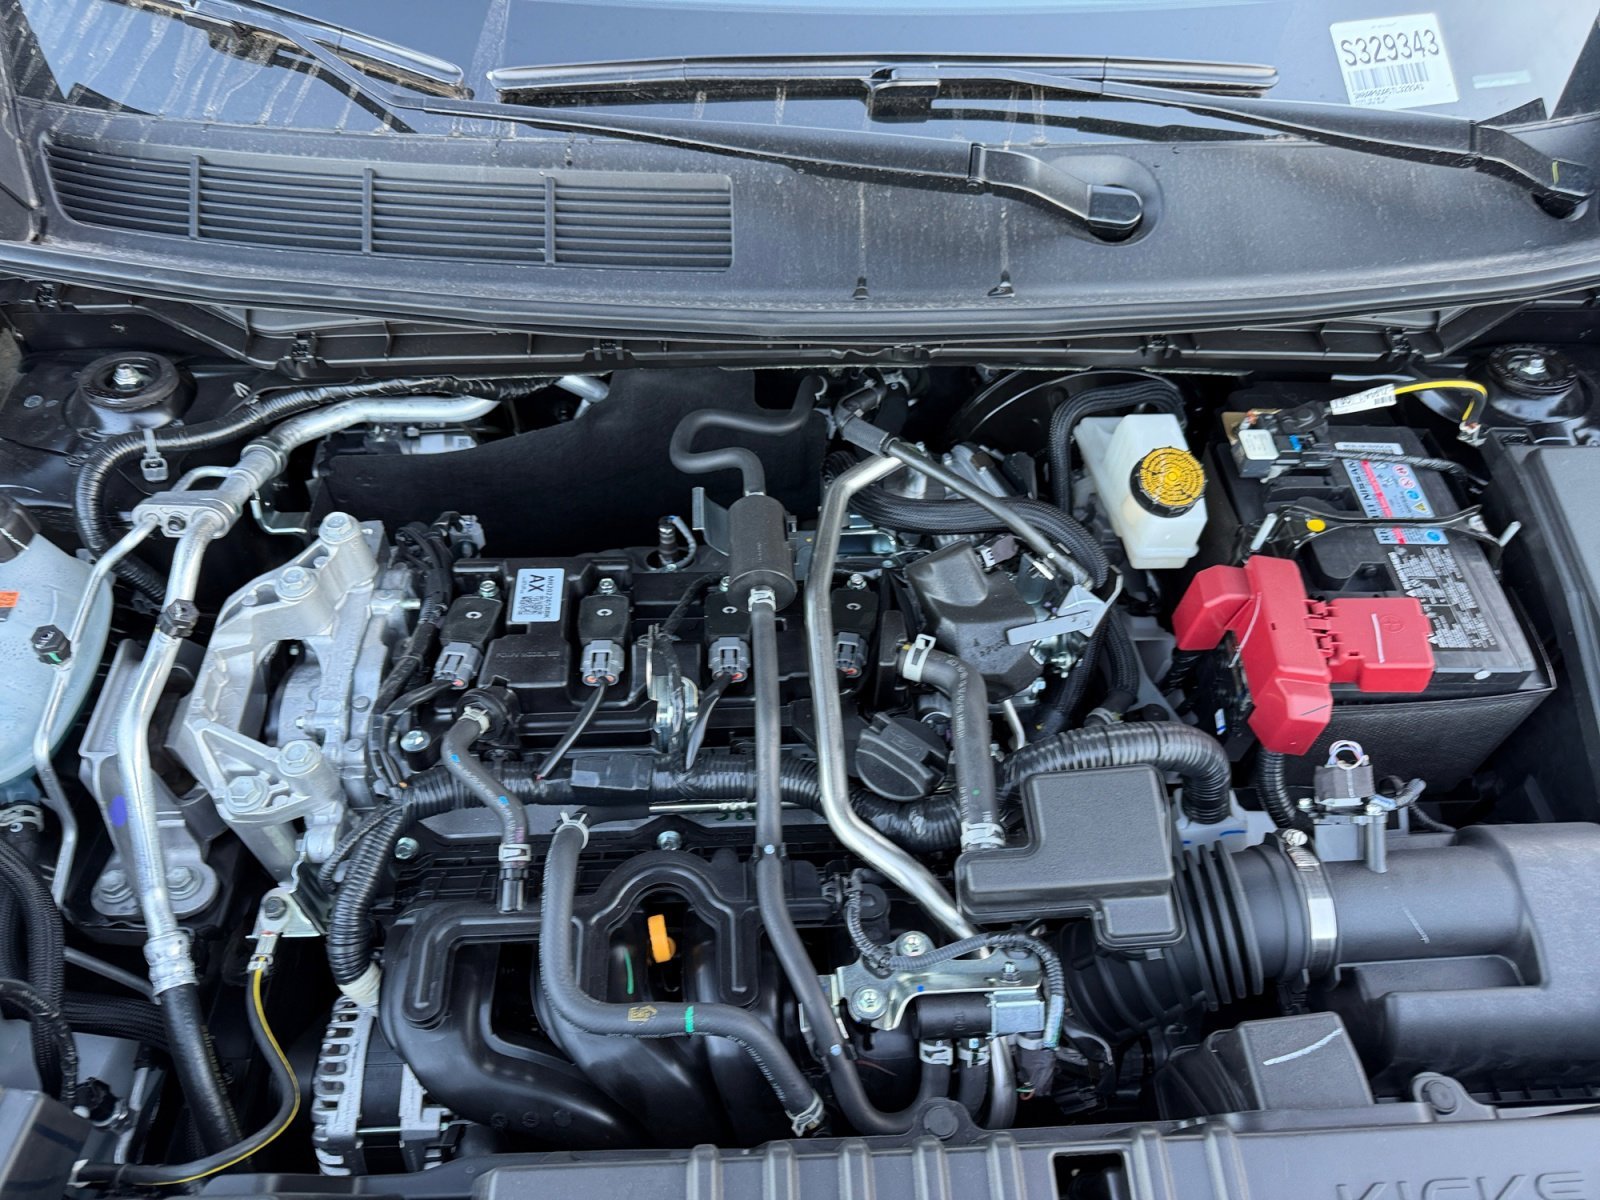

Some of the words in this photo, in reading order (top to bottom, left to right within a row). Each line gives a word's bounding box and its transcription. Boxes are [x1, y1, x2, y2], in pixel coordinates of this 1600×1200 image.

[1341, 29, 1439, 66] S329343
[1347, 461, 1371, 500] NISSAN
[528, 574, 545, 592] AX
